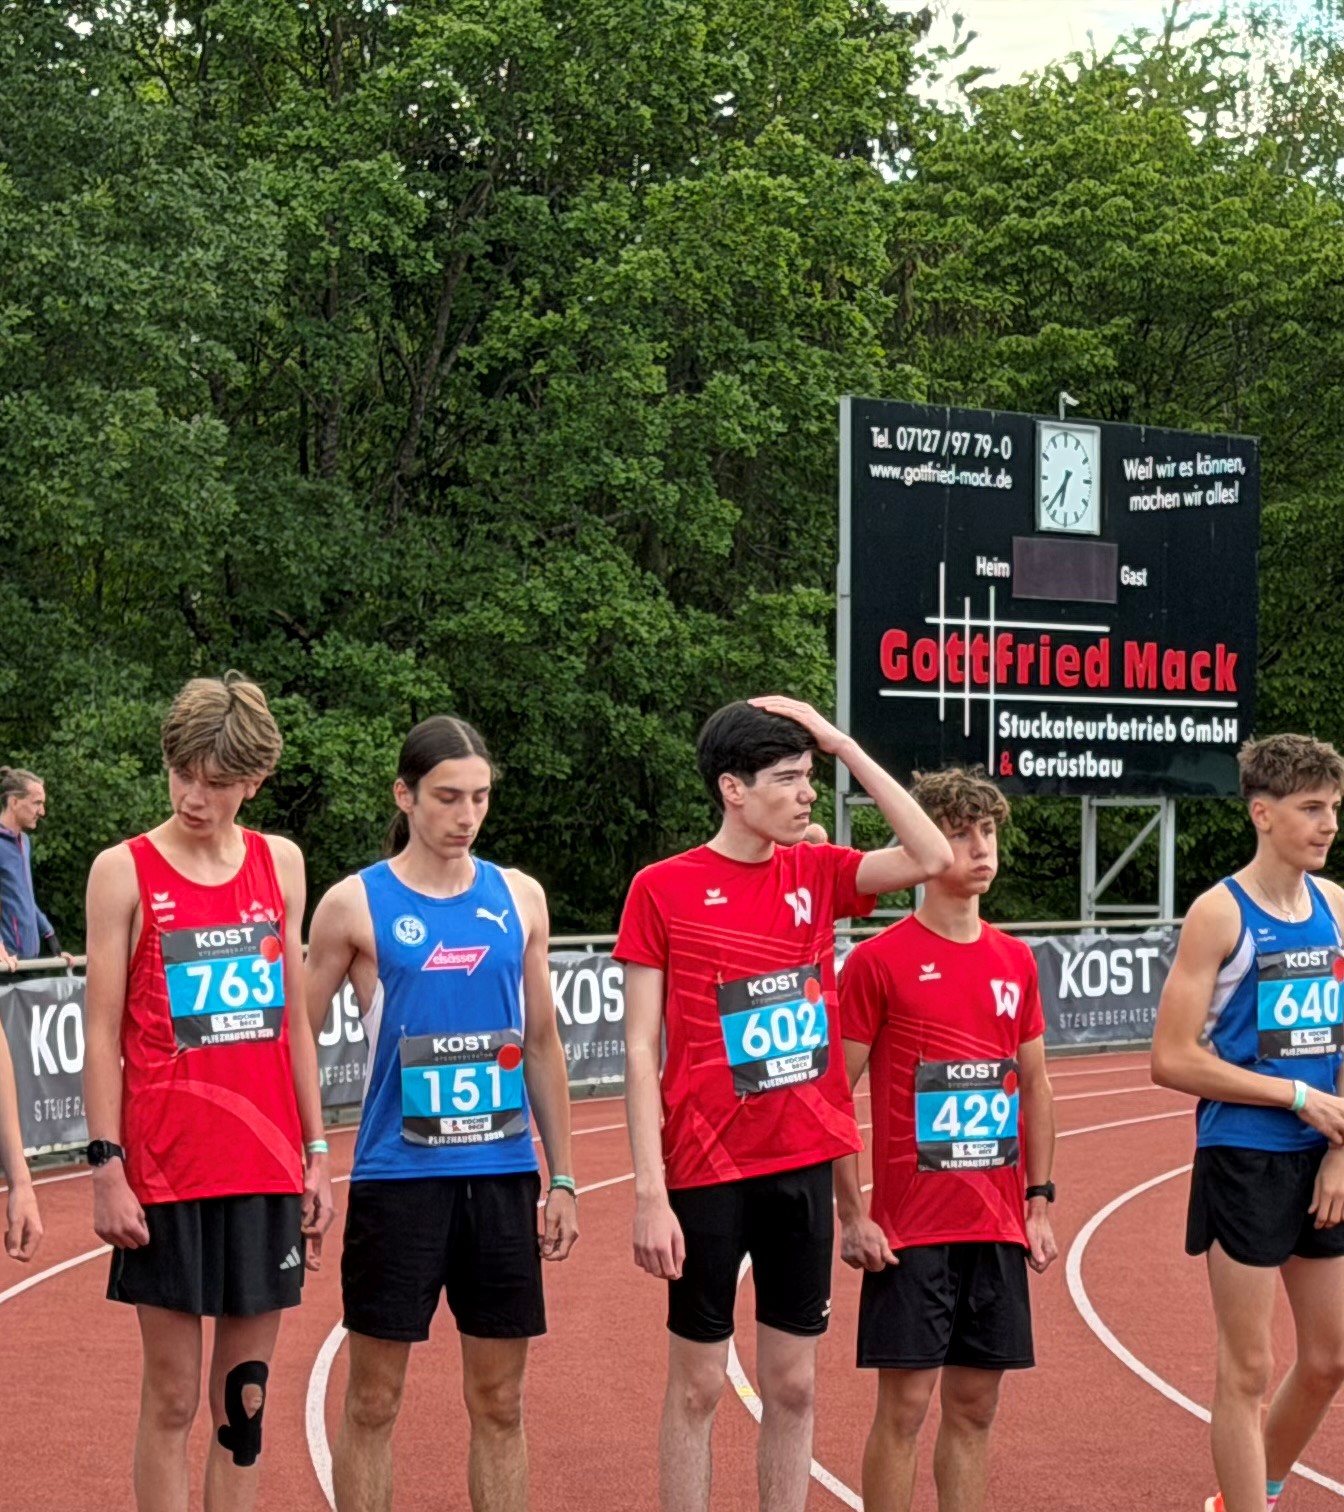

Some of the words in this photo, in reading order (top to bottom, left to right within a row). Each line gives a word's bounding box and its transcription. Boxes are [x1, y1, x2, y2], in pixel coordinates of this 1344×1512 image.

[871, 427, 892, 450] Tel.
[1123, 457, 1153, 482] Weil
[1155, 457, 1176, 480] wir
[1178, 460, 1194, 477] es
[1196, 453, 1246, 477] können,
[1129, 487, 1180, 512] machen
[1183, 484, 1203, 507] wir
[1206, 481, 1240, 506] alles!
[976, 556, 1010, 578] Heim
[1120, 566, 1148, 587] Gast
[880, 629, 1110, 688] Gottfried
[1123, 641, 1239, 692] Mack
[998, 711, 1176, 741] Stuckateurbetrieb
[1181, 718, 1239, 743] GmbH
[999, 751, 1014, 776] &
[1018, 750, 1123, 778] Gerüstbau
[195, 927, 254, 948] KOST
[1059, 948, 1159, 998] KOST
[1285, 950, 1329, 968] KOST
[186, 958, 275, 1011] 763
[550, 967, 624, 1025] KOS
[747, 972, 799, 996] KOST
[1060, 1007, 1157, 1029] STEUERBERATER
[1274, 981, 1340, 1026] 640
[31, 1003, 85, 1076] KO
[433, 1035, 491, 1053] KOST
[742, 1003, 821, 1057] 602
[946, 1063, 1001, 1079] KOST
[423, 1066, 501, 1112] 151
[932, 1094, 1010, 1137] 429
